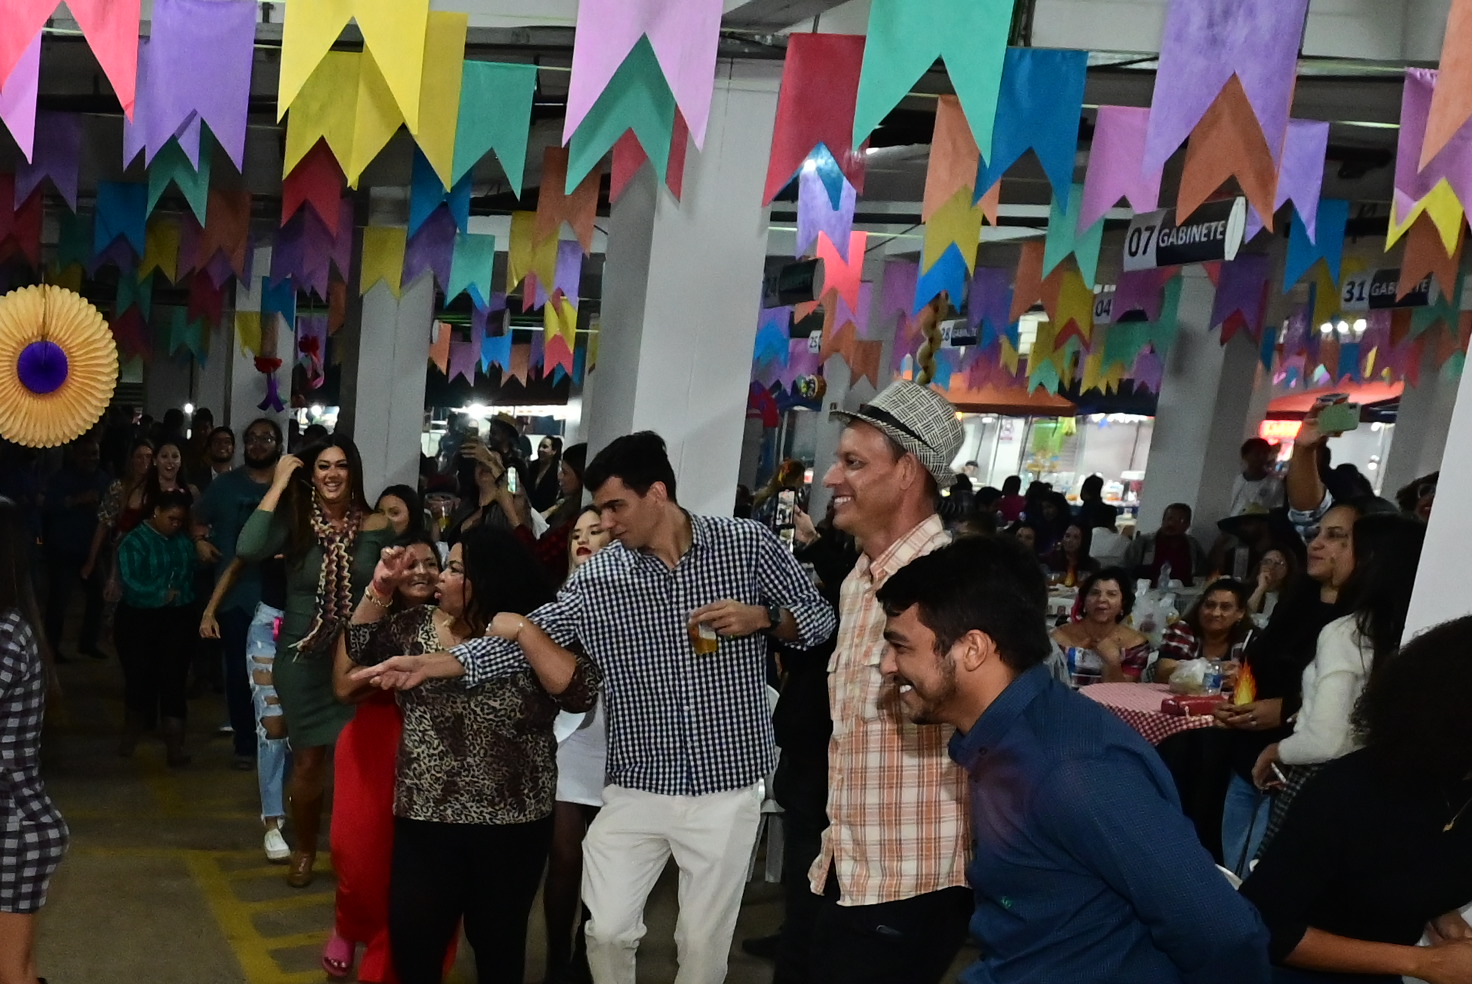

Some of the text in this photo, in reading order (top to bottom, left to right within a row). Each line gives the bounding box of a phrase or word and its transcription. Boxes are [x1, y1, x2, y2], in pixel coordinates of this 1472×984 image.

[1128, 220, 1226, 257] 07 GABINETE
[1343, 280, 1367, 302] 31
[1095, 298, 1112, 317] 04
